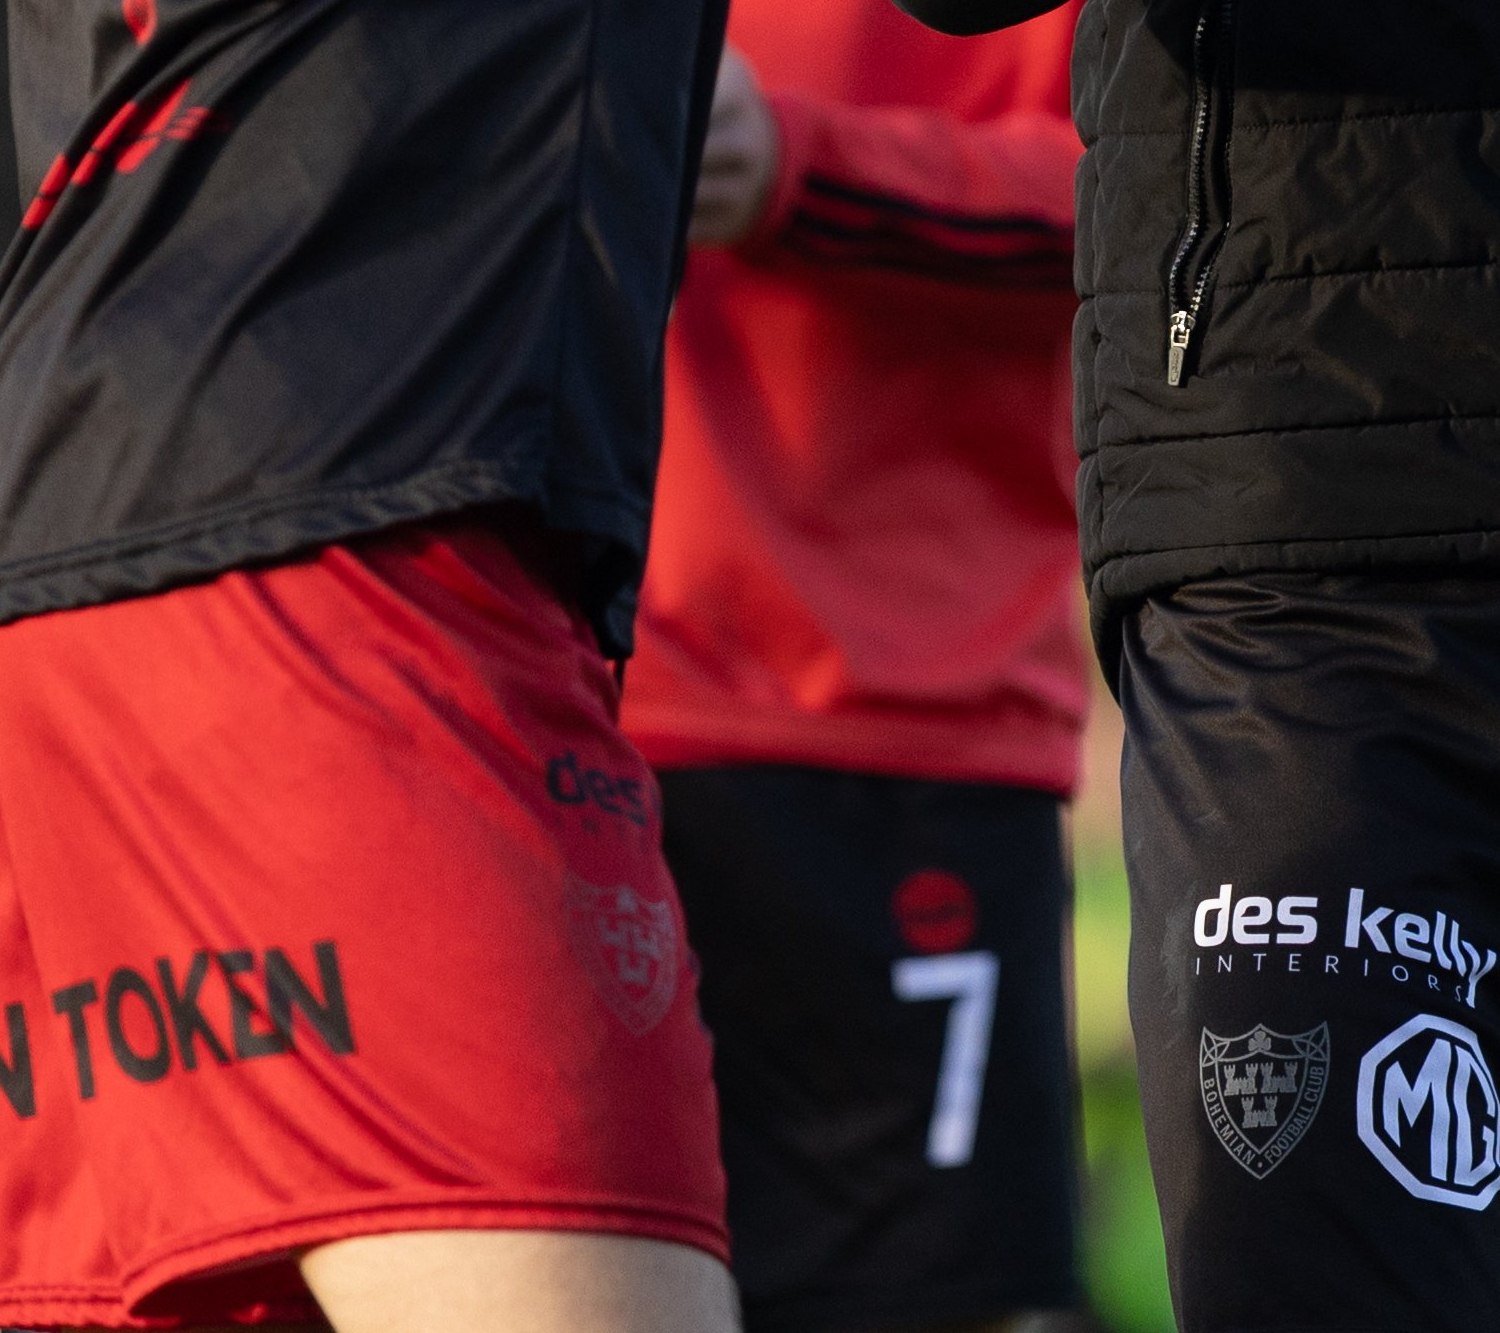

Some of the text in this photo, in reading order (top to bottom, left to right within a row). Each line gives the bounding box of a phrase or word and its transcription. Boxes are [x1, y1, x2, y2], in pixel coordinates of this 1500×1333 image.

[1194, 884, 1497, 1009] des kelly
[1195, 953, 1464, 1003] INTERIORS
[52, 940, 357, 1101] TOKEN
[890, 950, 1000, 1169] 7
[1203, 1064, 1326, 1167] BOHEMIAN FOOTBALL CLUB
